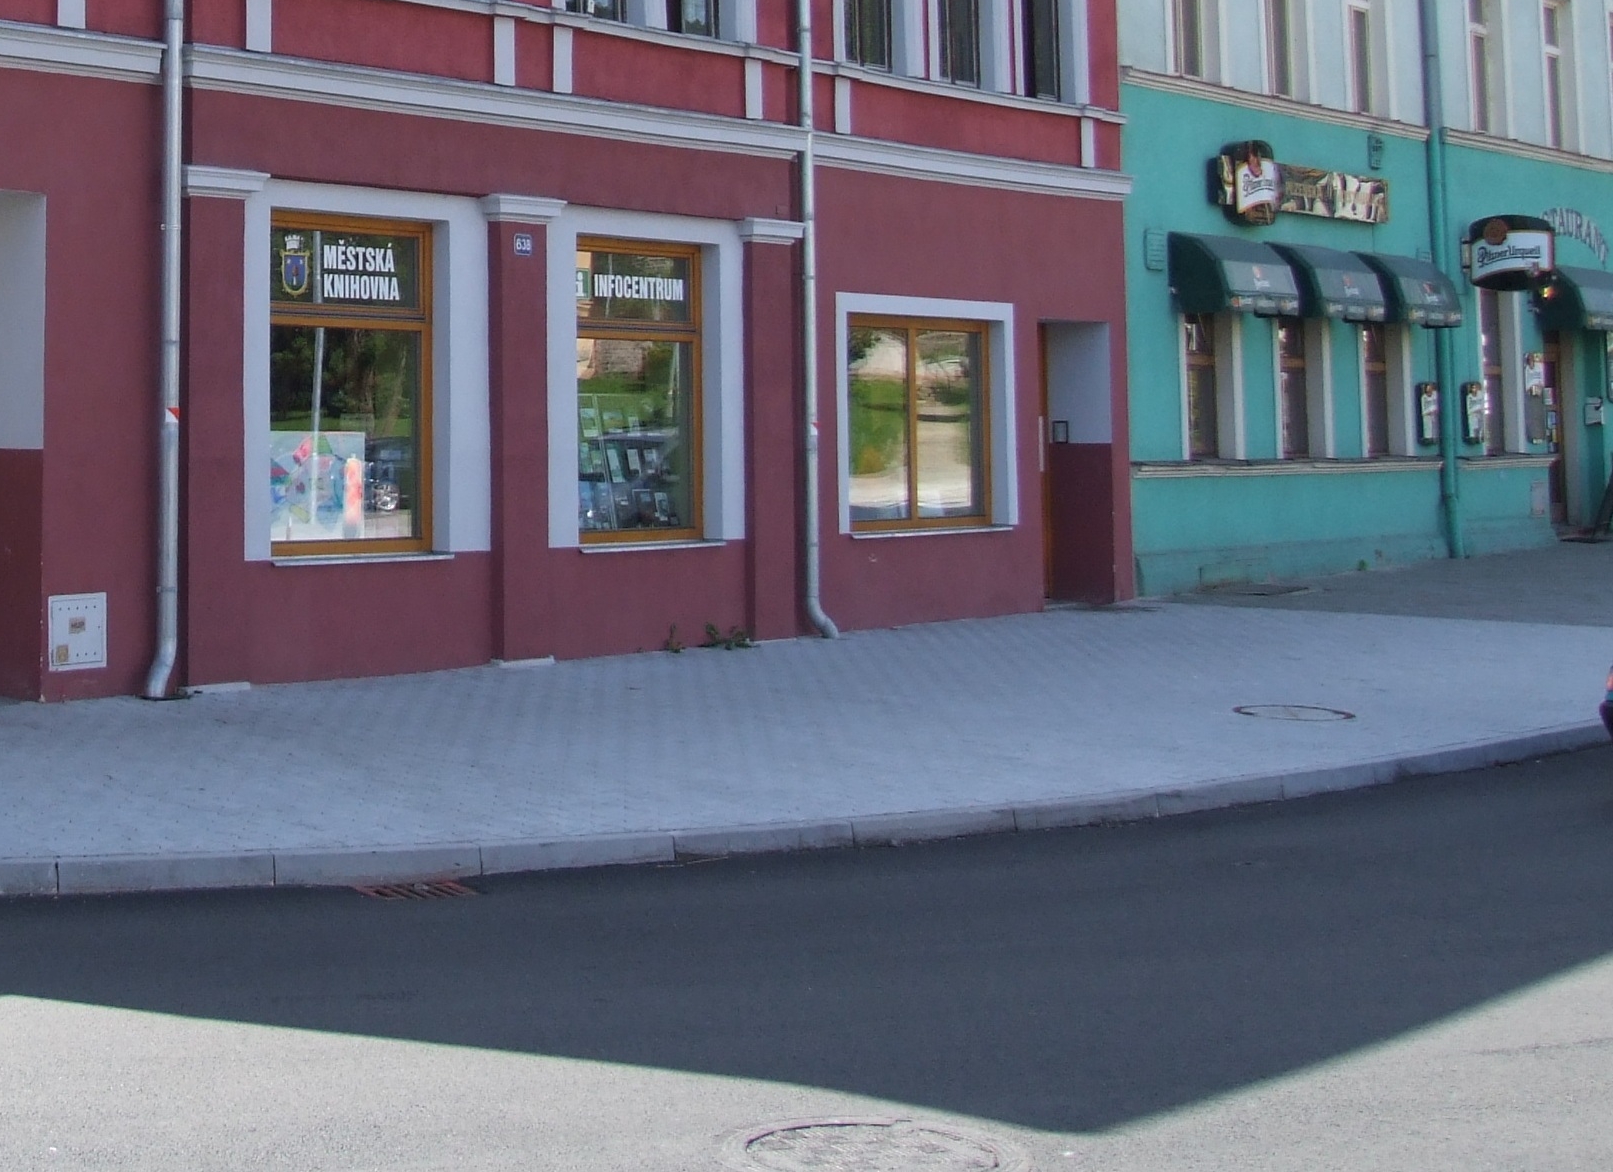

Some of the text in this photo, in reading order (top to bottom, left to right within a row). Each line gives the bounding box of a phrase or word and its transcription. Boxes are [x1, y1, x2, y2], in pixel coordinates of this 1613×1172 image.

[323, 239, 395, 272] MĚSTSKÁ
[323, 274, 400, 301] KNIHOVNA
[594, 273, 684, 301] INFOCENTRUM
